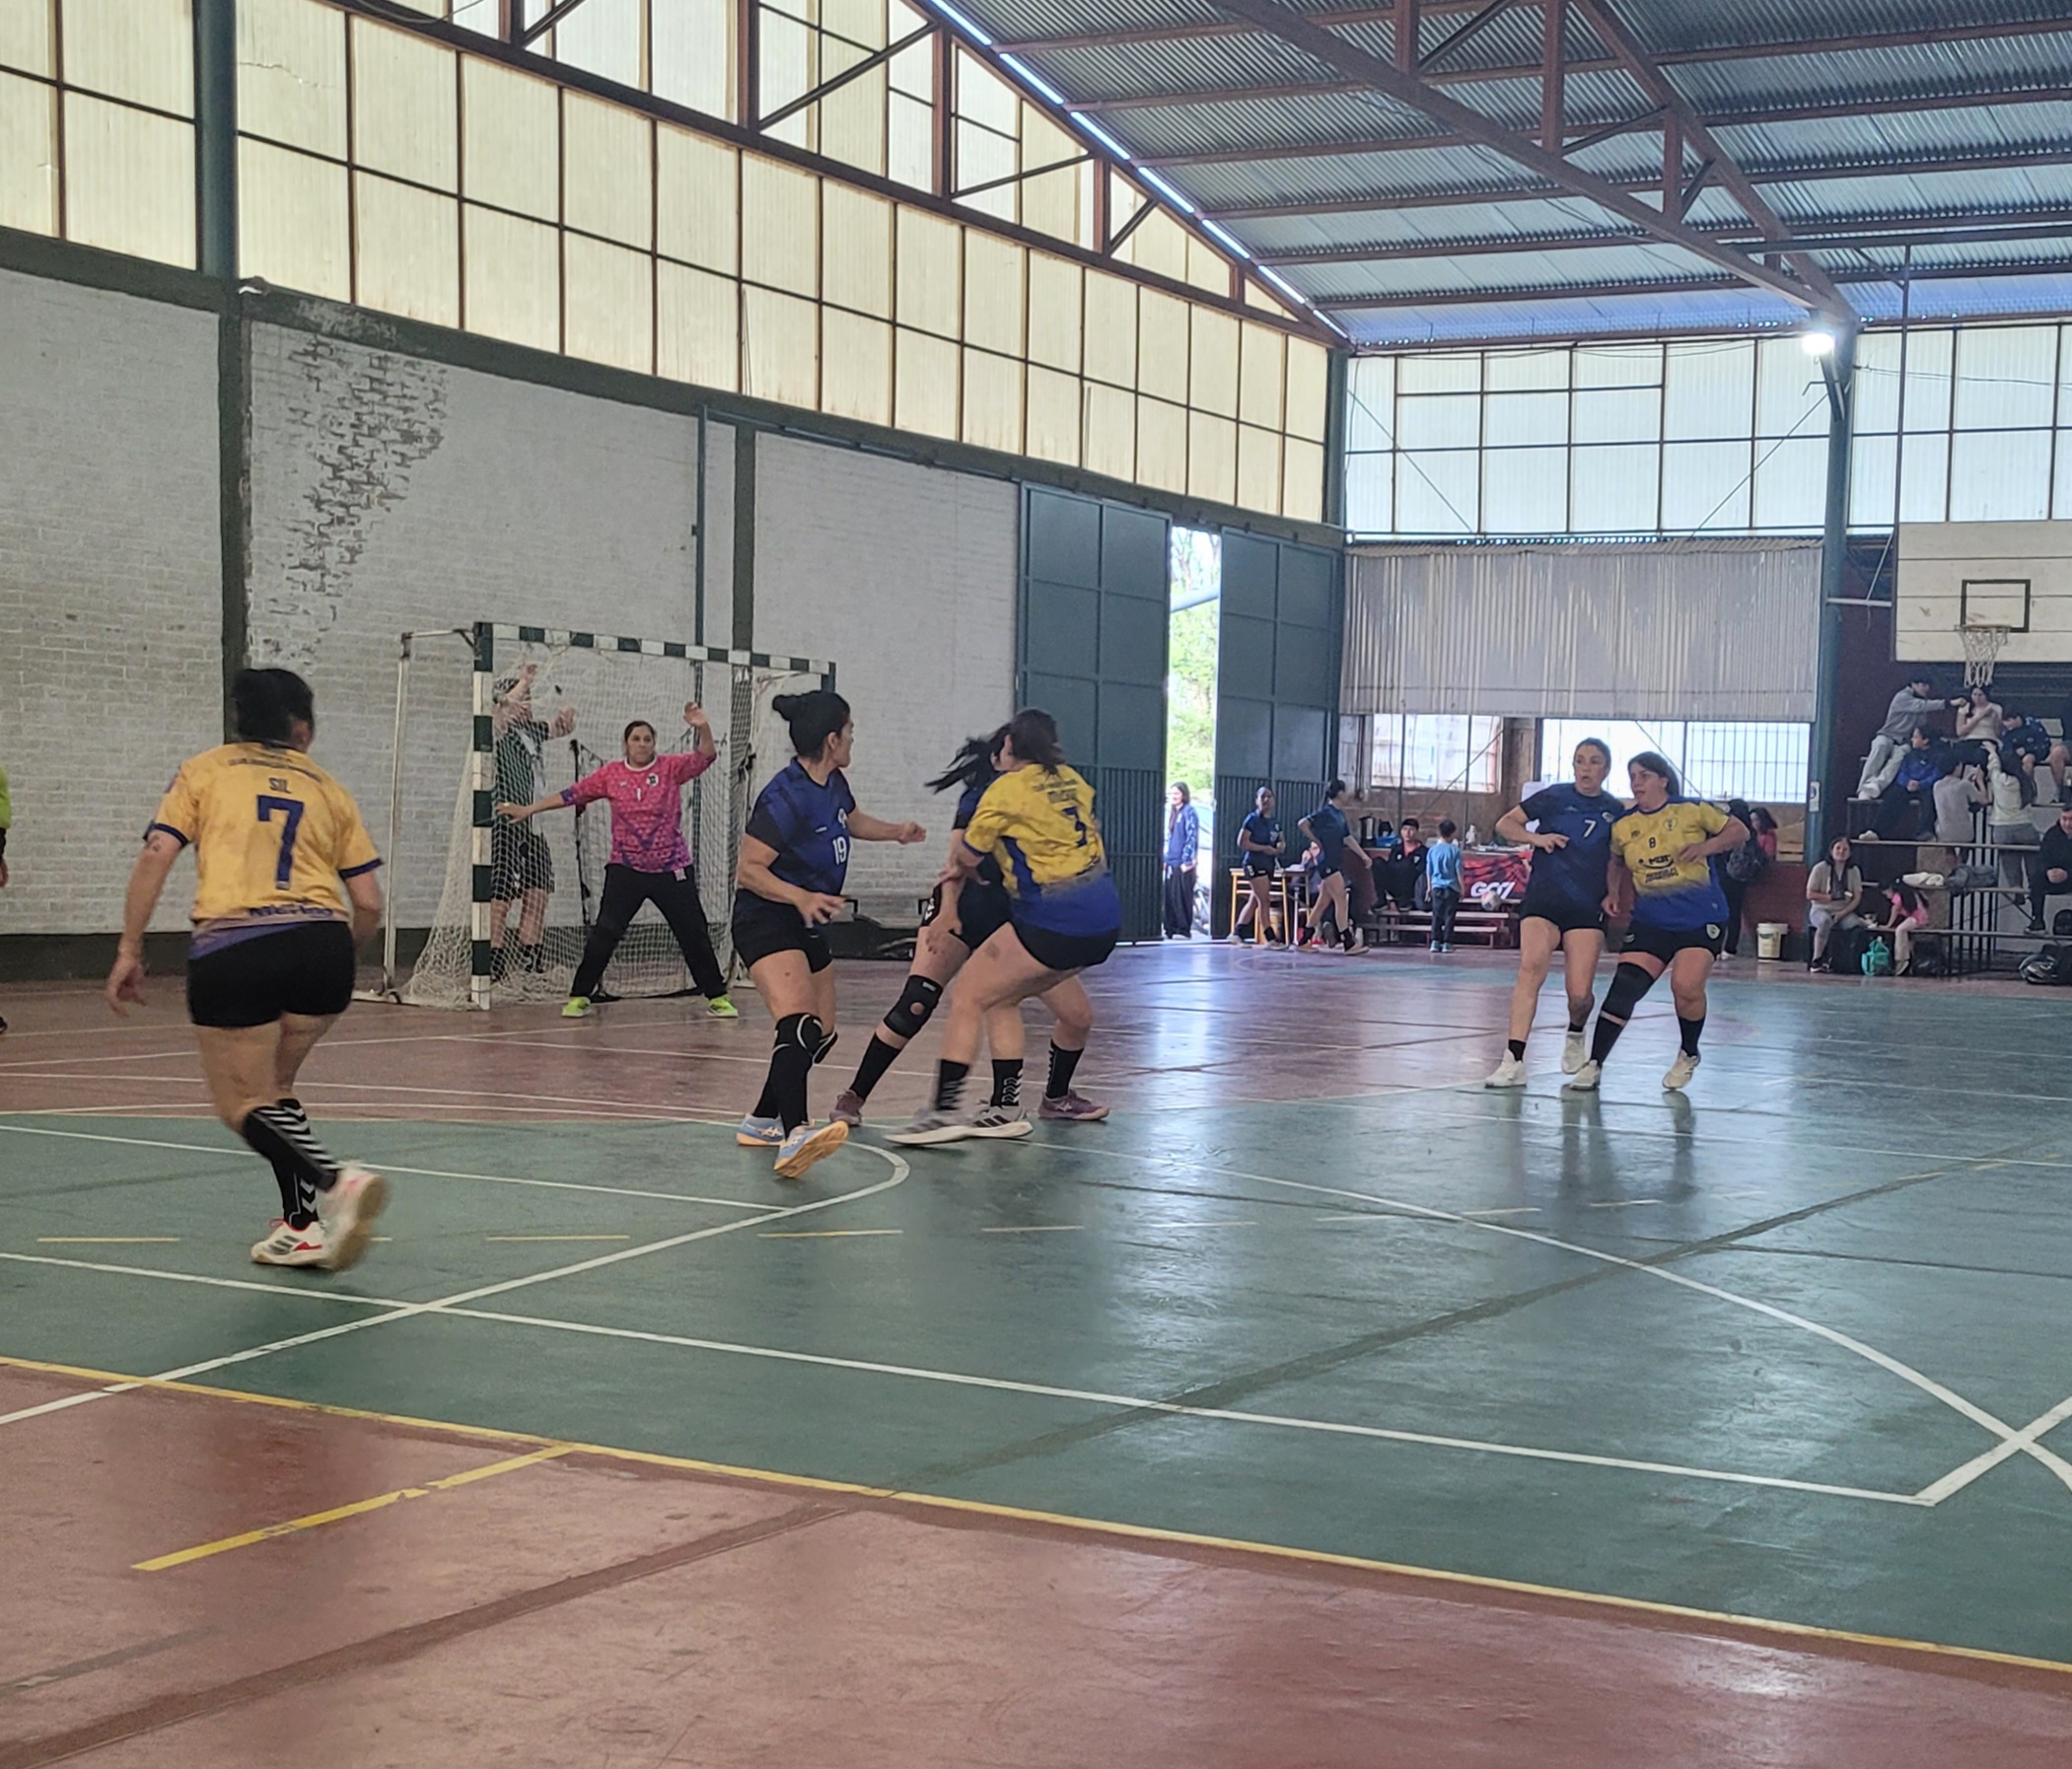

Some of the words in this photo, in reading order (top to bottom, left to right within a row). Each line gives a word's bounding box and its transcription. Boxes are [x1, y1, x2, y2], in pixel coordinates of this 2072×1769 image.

[1584, 818, 1597, 839] 7
[256, 795, 304, 890] 7
[832, 835, 848, 866] 19
[1648, 836, 1657, 849] 8
